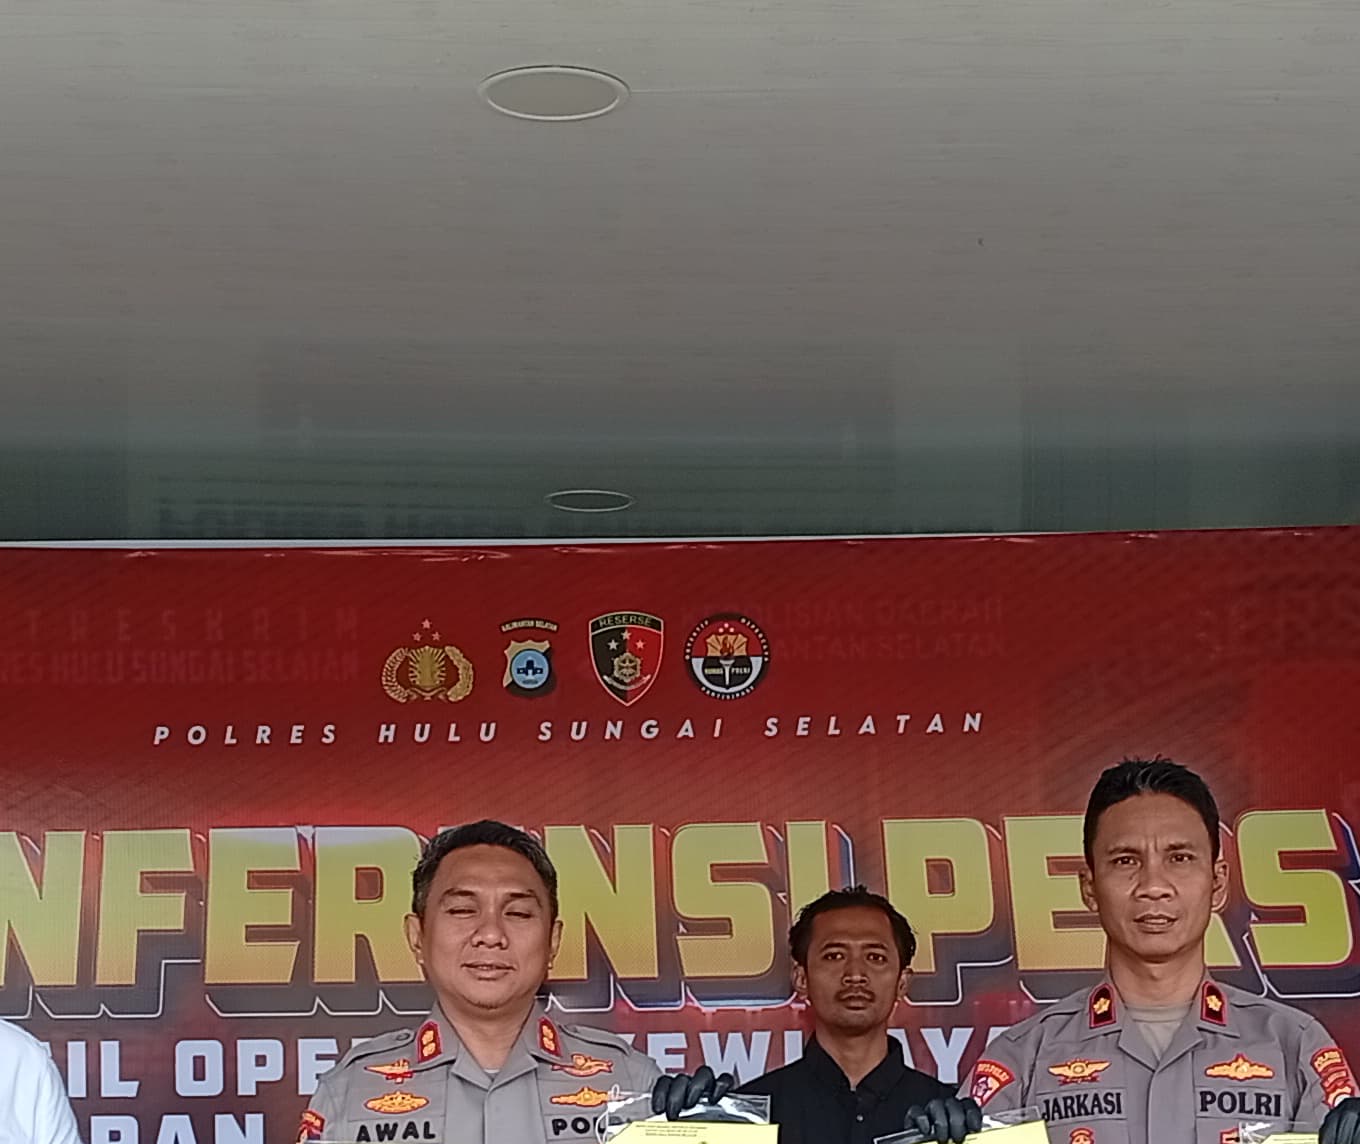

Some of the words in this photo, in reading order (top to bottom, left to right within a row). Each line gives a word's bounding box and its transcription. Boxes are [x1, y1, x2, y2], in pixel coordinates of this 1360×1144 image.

[599, 615, 653, 628] RESERSE
[154, 723, 337, 745] POLRES
[378, 722, 499, 743] HULU
[538, 717, 723, 741] SUNGAI
[764, 712, 986, 737] SELATAN
[880, 809, 1356, 974] PES
[1041, 1091, 1123, 1122] JARKASI
[1199, 1090, 1283, 1118] POLRI
[356, 1120, 437, 1143] AWAL
